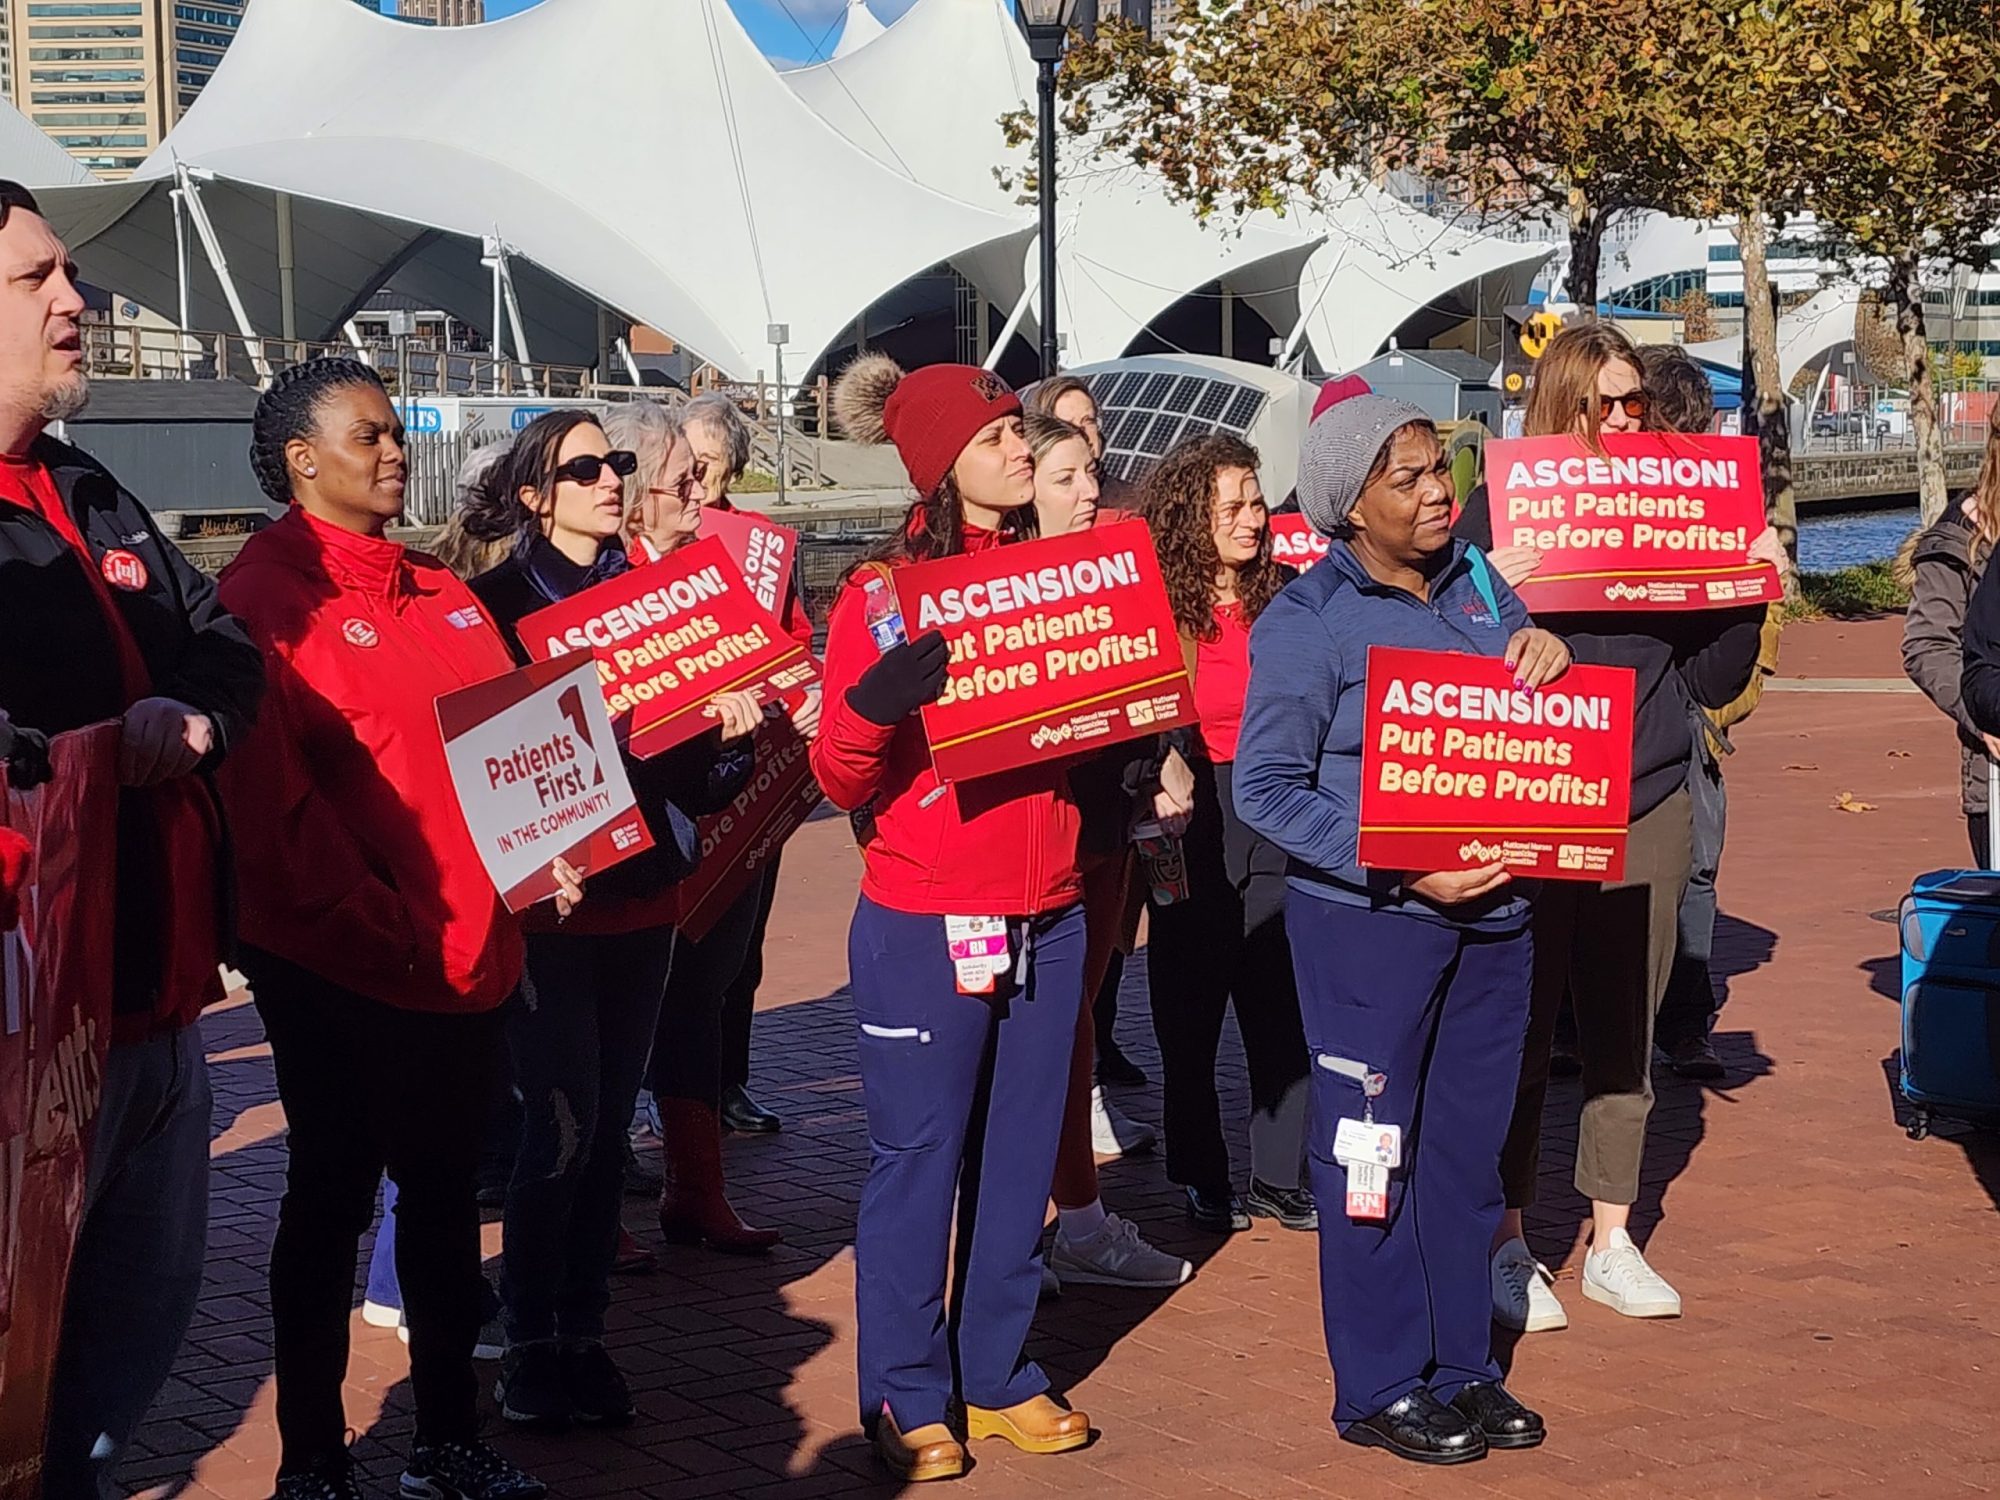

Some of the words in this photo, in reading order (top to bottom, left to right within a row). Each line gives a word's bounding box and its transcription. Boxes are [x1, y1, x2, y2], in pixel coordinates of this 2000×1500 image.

[1505, 457, 1739, 490] ASCENSION!
[1508, 495, 1565, 521] Put
[1575, 492, 1705, 519] Patients
[1513, 524, 1624, 550] Before
[1633, 523, 1747, 550] Profits!
[756, 531, 785, 612] ENTS
[918, 551, 1141, 629] ASCENSION!
[546, 565, 729, 658] ASCENSION!
[946, 631, 978, 664] ut
[984, 604, 1114, 659] Patients
[606, 665, 680, 718] efore
[675, 623, 771, 681] Profits!
[613, 614, 721, 675] Patients
[1045, 627, 1160, 681] Profits!
[1382, 679, 1610, 730] ASCENSION!
[484, 733, 576, 790] Patients
[1379, 723, 1436, 755] Put
[1443, 728, 1572, 766] Patients
[534, 763, 587, 808] First
[1379, 762, 1487, 798] Before
[1495, 770, 1610, 806] Profits!
[497, 833, 515, 855] IN
[513, 822, 540, 846] THE
[540, 790, 612, 835] COMMUNITY
[1351, 1193, 1380, 1208] RN
